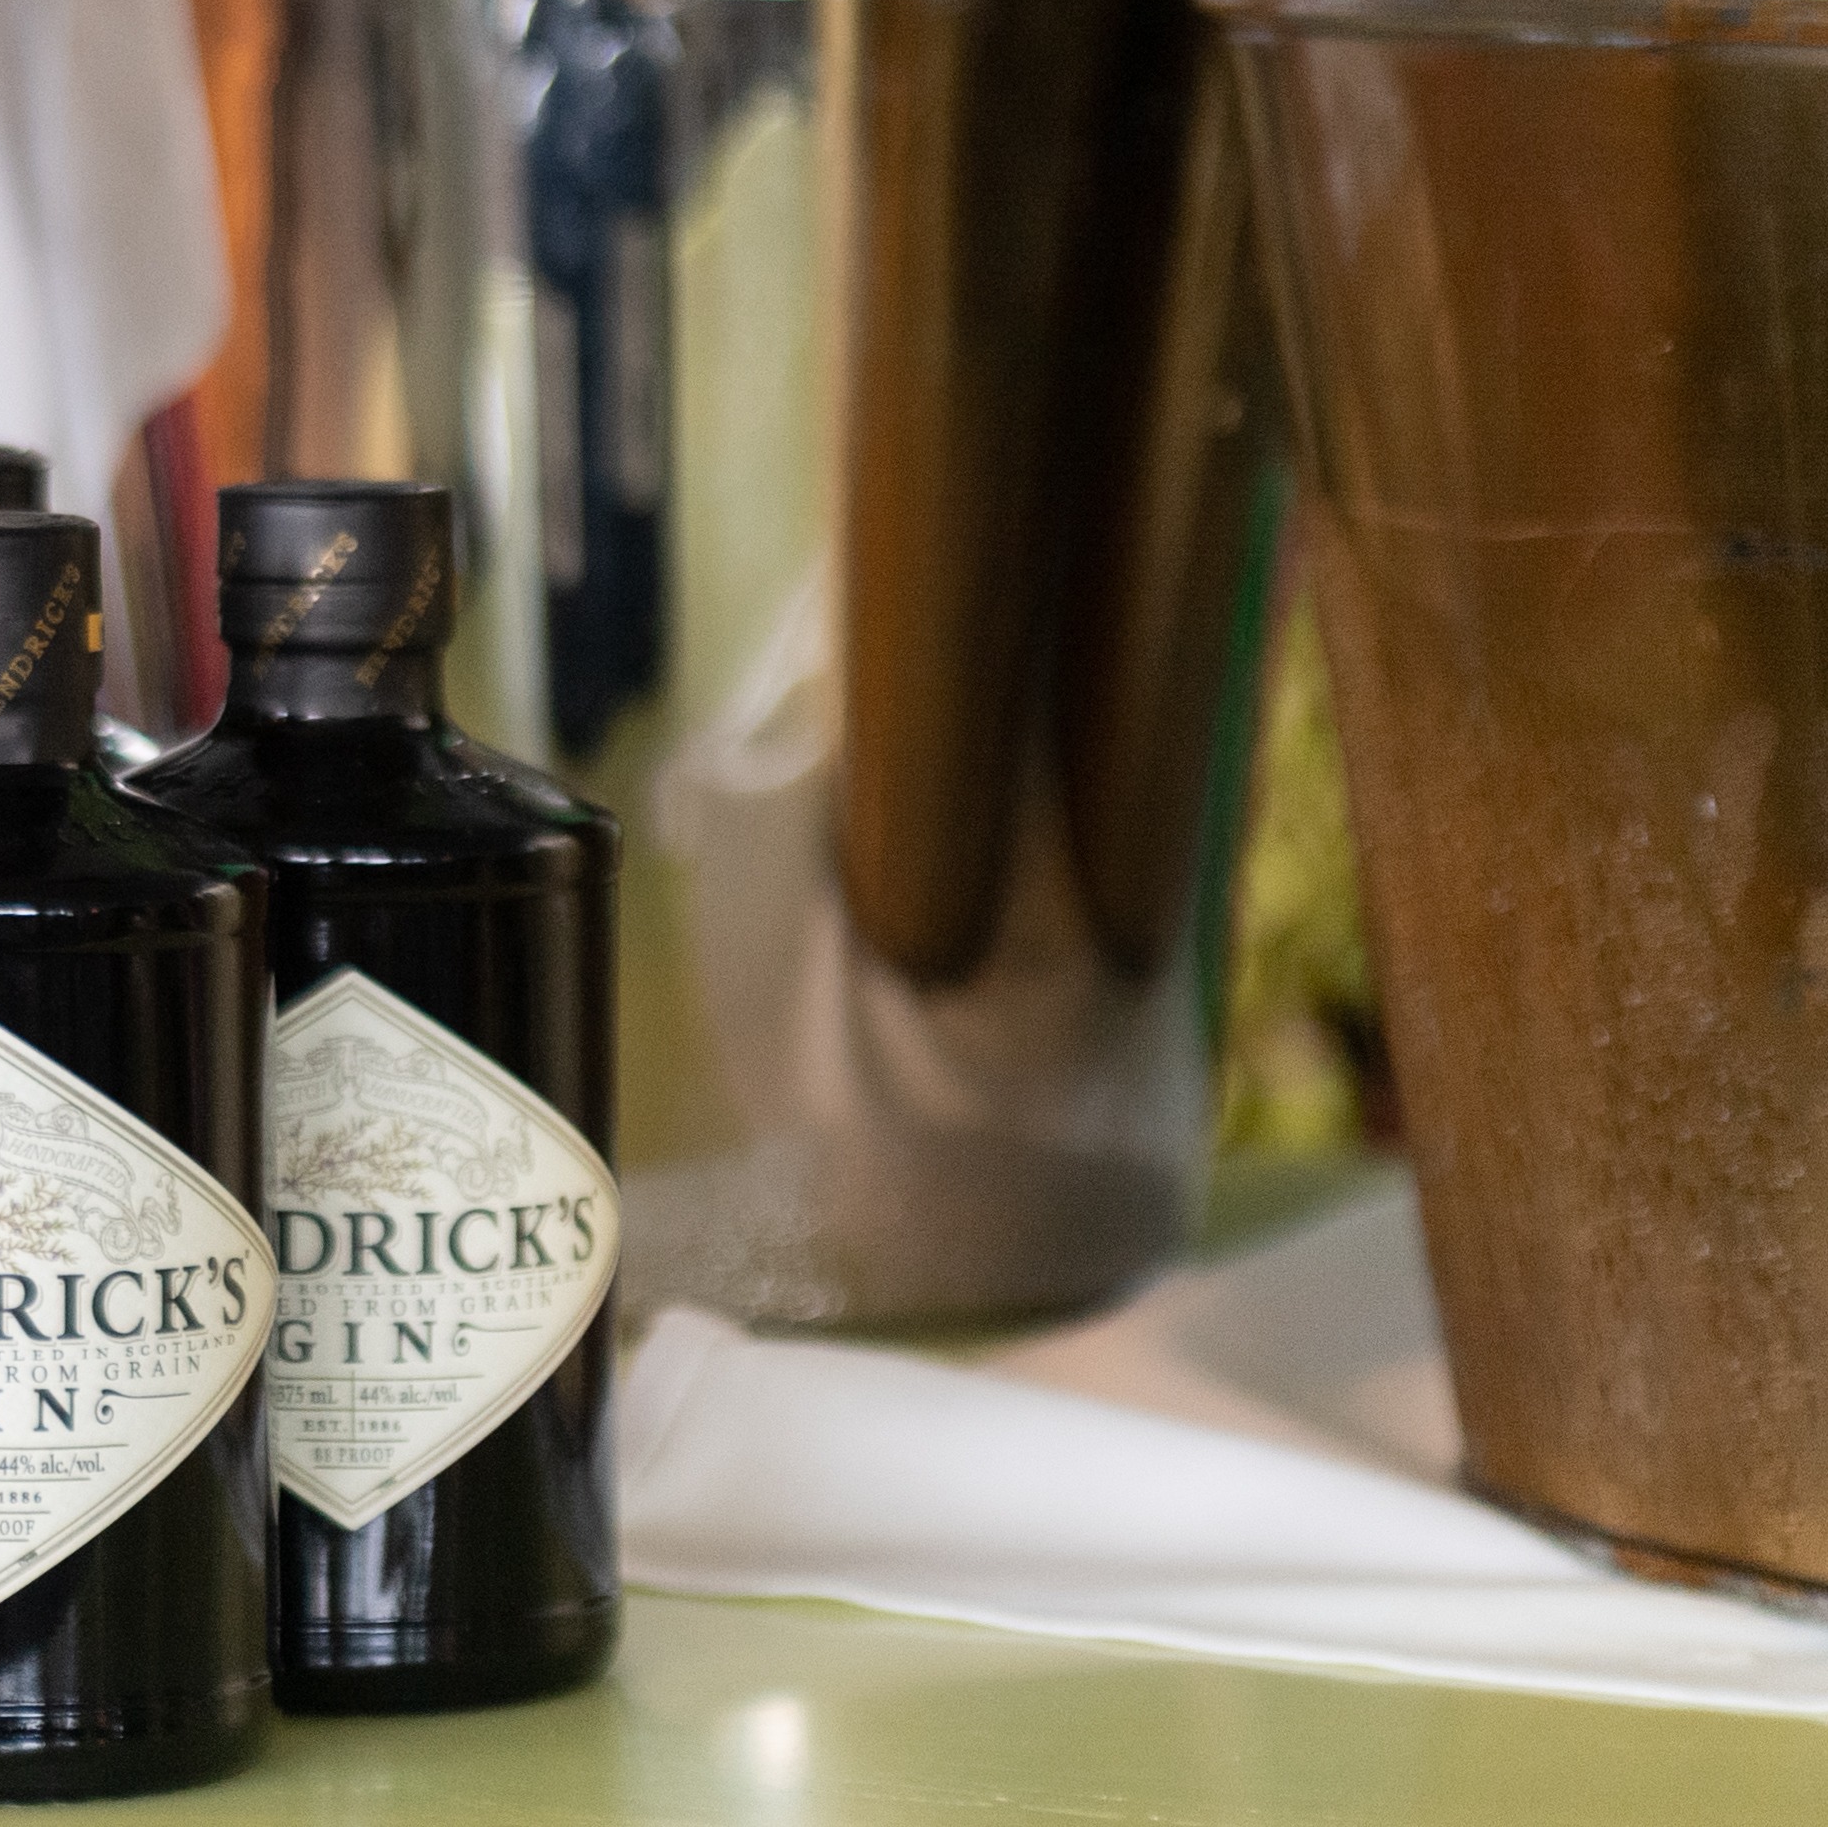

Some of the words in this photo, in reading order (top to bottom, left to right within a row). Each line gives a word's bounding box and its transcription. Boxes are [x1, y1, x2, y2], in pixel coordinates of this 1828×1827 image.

[276, 1195, 595, 1276] DRICK'S
[342, 1298, 437, 1317] FROM
[459, 1290, 554, 1315] GRAIN
[82, 1347, 109, 1359] IN
[125, 1333, 236, 1358] SCOTLAND
[276, 1320, 433, 1364] GIN
[103, 1354, 202, 1381] GRAIN
[359, 1386, 395, 1405] 44%
[40, 1452, 105, 1477] alc./vol.
